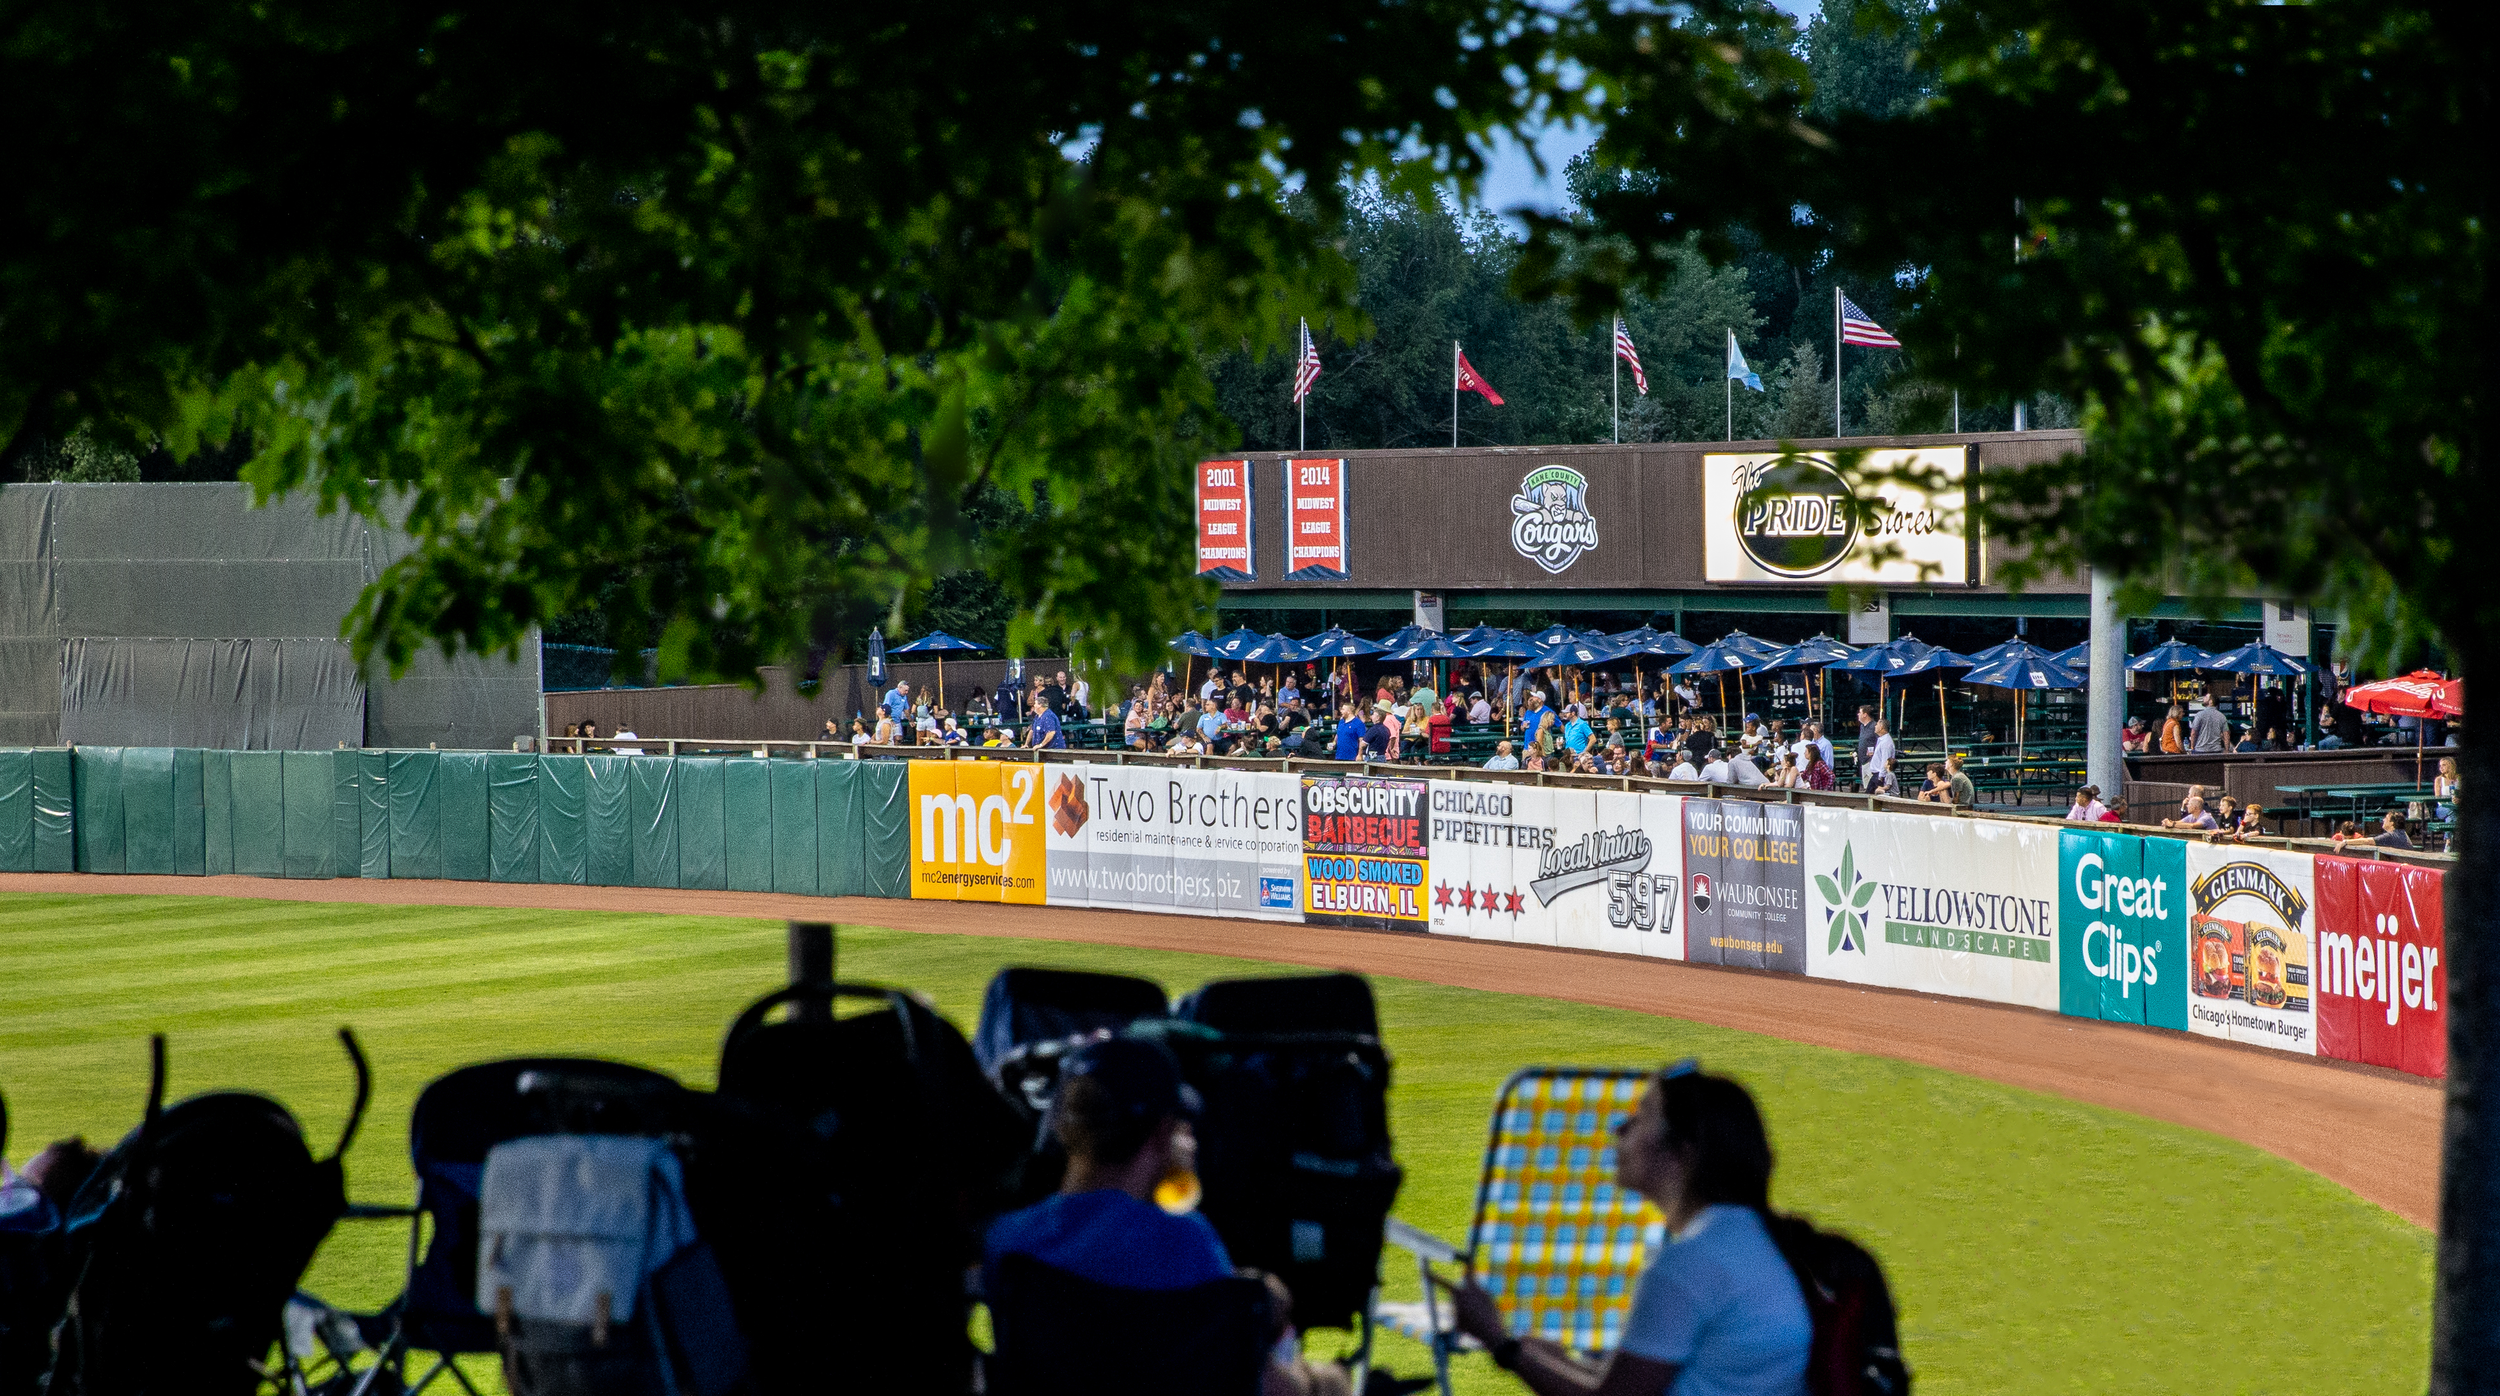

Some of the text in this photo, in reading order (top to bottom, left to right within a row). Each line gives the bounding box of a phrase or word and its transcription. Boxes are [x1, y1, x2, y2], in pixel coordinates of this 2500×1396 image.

[1206, 468, 1236, 487] 2001
[1301, 466, 1330, 485] 2014
[1531, 469, 1578, 485] KANE COUNTY
[1732, 462, 1762, 498] The
[1203, 498, 1241, 511] MIDWEST
[1296, 497, 1335, 510] MIDWEST
[1744, 496, 1934, 537] PRIDE Stores
[1208, 523, 1238, 535] LEAGUE
[1301, 521, 1331, 534] LEAGUE
[1515, 512, 1595, 561] Cougars
[1200, 547, 1246, 559] CHAMPIONS
[1293, 546, 1339, 558] CHAMPIONS
[1090, 777, 1298, 832] Two Brothers
[1307, 785, 1420, 816] OBSCURITY
[1433, 789, 1513, 817] CHICAGO
[1307, 815, 1420, 847] BARBECUE
[1433, 818, 1557, 849] PIPEFITTERS'
[1690, 811, 1798, 838] YOUR COMMUNITY
[1145, 833, 1202, 848] maintenance
[1204, 835, 1212, 848] &
[1245, 840, 1299, 854] corporation
[1538, 824, 1644, 879] Local Union
[1690, 834, 1798, 865] YOUR COLLEGE
[922, 871, 1035, 888] mc2energyservices.com
[1051, 865, 1241, 899] www.twobrothers.biz
[1262, 867, 1291, 876] powered by
[1308, 858, 1423, 885] WOOD SMOKED
[2075, 852, 2168, 920] Great
[1312, 884, 1418, 916] ELBURN, IL
[1607, 869, 1678, 934] 597
[1715, 882, 1798, 909] WAUBONSEE
[2210, 868, 2287, 911] GLENMARK
[1727, 908, 1761, 920] COMMUNITY
[1881, 883, 2052, 937] YELLOWSTONE
[1710, 935, 1783, 954] waubonsee.edu
[1903, 927, 2030, 957] LANDSCAPE
[2082, 920, 2158, 999] Clips
[2320, 913, 2438, 1026] meijer
[2287, 972, 2308, 984] PATTIES
[2192, 1004, 2307, 1042] Chicago's Hometown Burger
